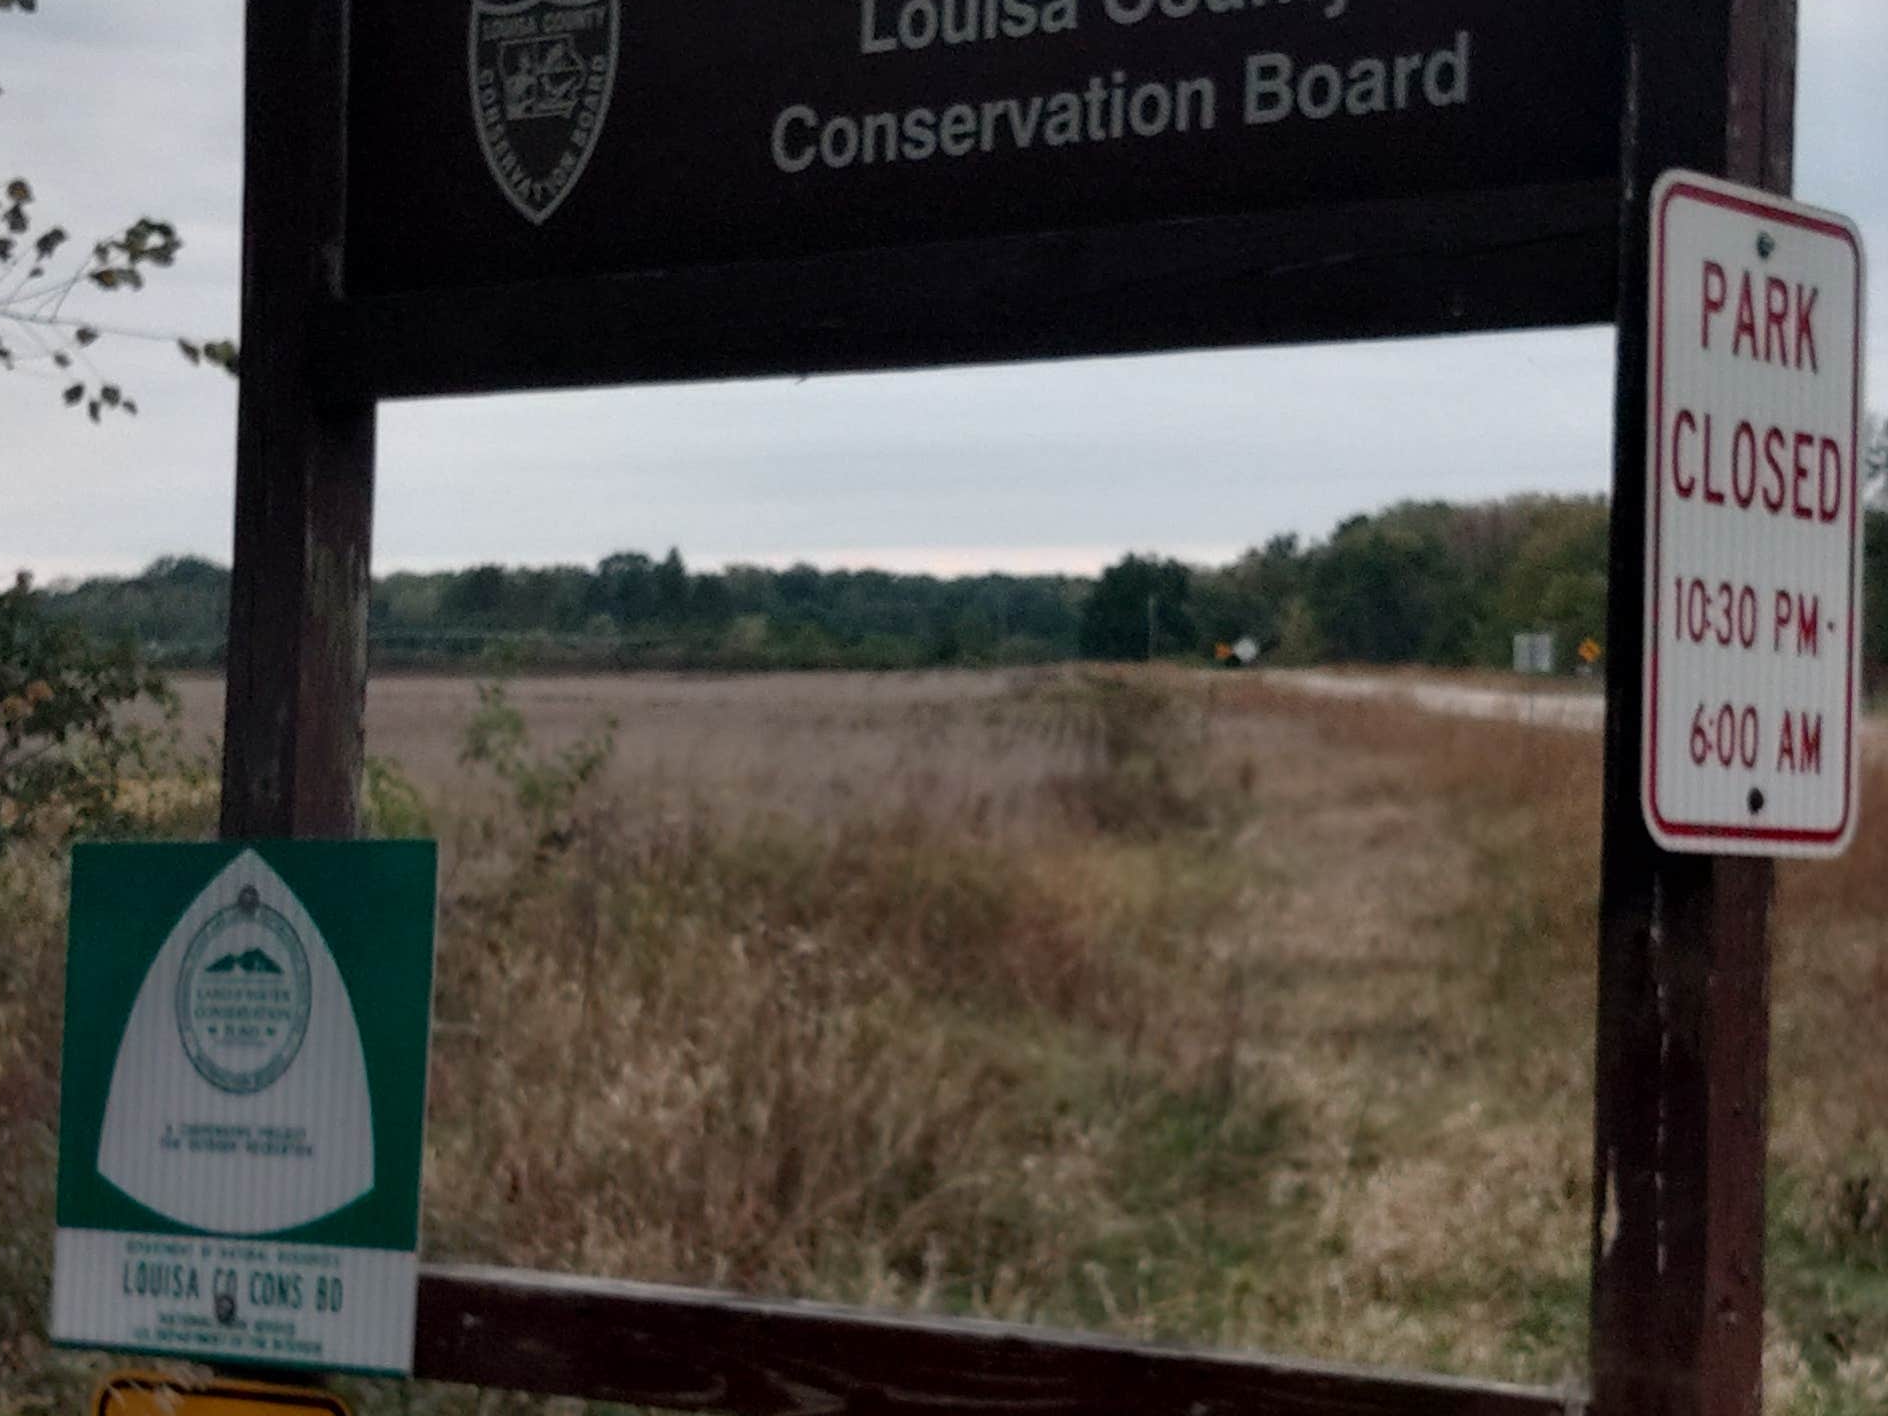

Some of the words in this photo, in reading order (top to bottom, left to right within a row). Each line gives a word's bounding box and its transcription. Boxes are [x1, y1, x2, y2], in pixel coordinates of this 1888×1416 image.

[771, 72, 1215, 172] Conservation
[1244, 31, 1469, 124] Board
[1702, 259, 1820, 373] PARK
[1672, 409, 1842, 524] CLOSED
[1674, 577, 1758, 650] 10:30
[1689, 703, 1759, 770] 6:00
[1778, 711, 1822, 774] AM
[122, 1261, 200, 1300] LOUISA
[249, 1270, 303, 1310] CONS
[316, 1275, 344, 1313] BD
